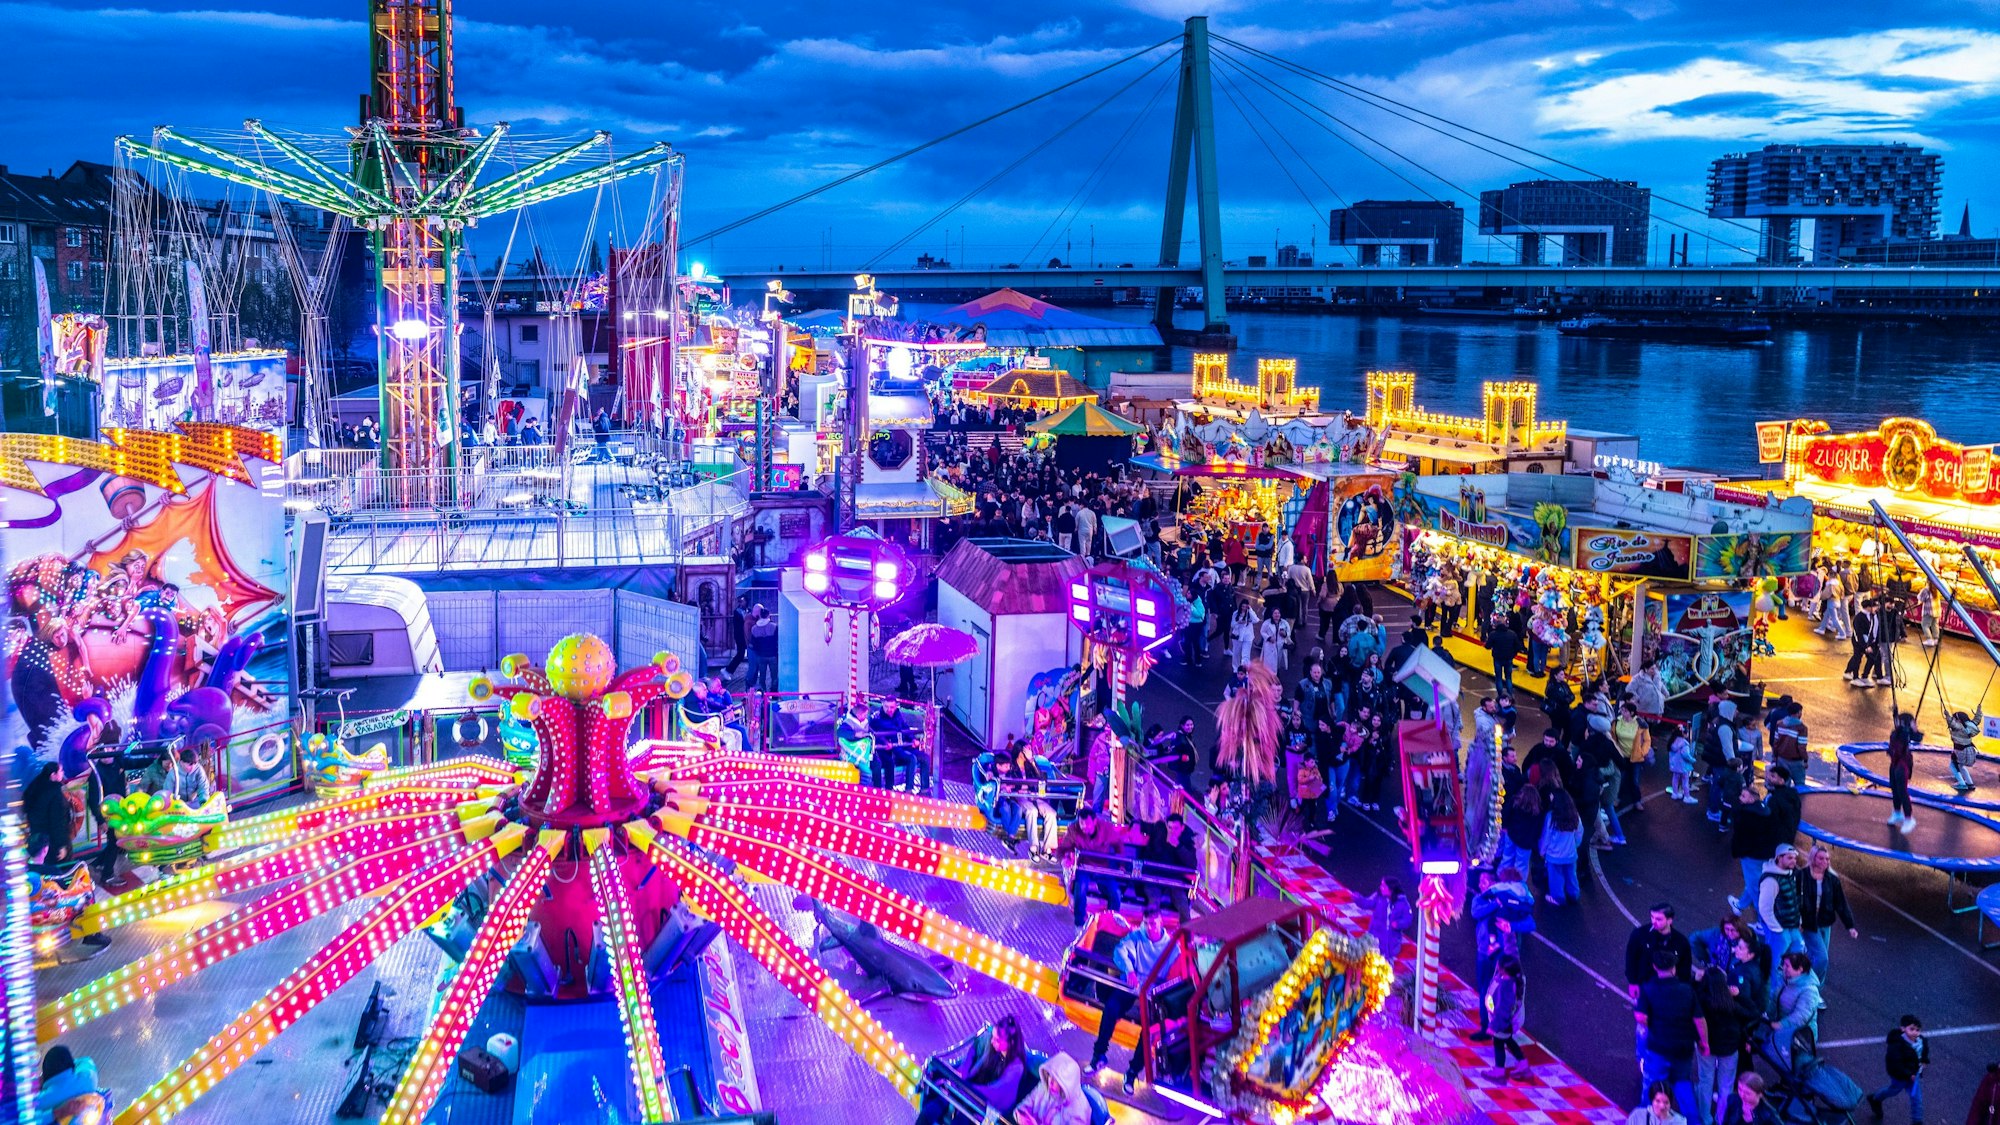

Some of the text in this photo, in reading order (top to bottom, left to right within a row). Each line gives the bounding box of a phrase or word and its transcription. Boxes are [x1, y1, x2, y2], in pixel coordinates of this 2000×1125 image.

[1814, 448, 1873, 473] ZUCKER
[1588, 535, 1630, 551] Rio
[1590, 550, 1654, 571] Janeiro
[353, 716, 381, 727] ANOTHER
[381, 713, 395, 721] DAY
[355, 720, 395, 735] PARADISE
[707, 1014, 753, 1114] Beach
